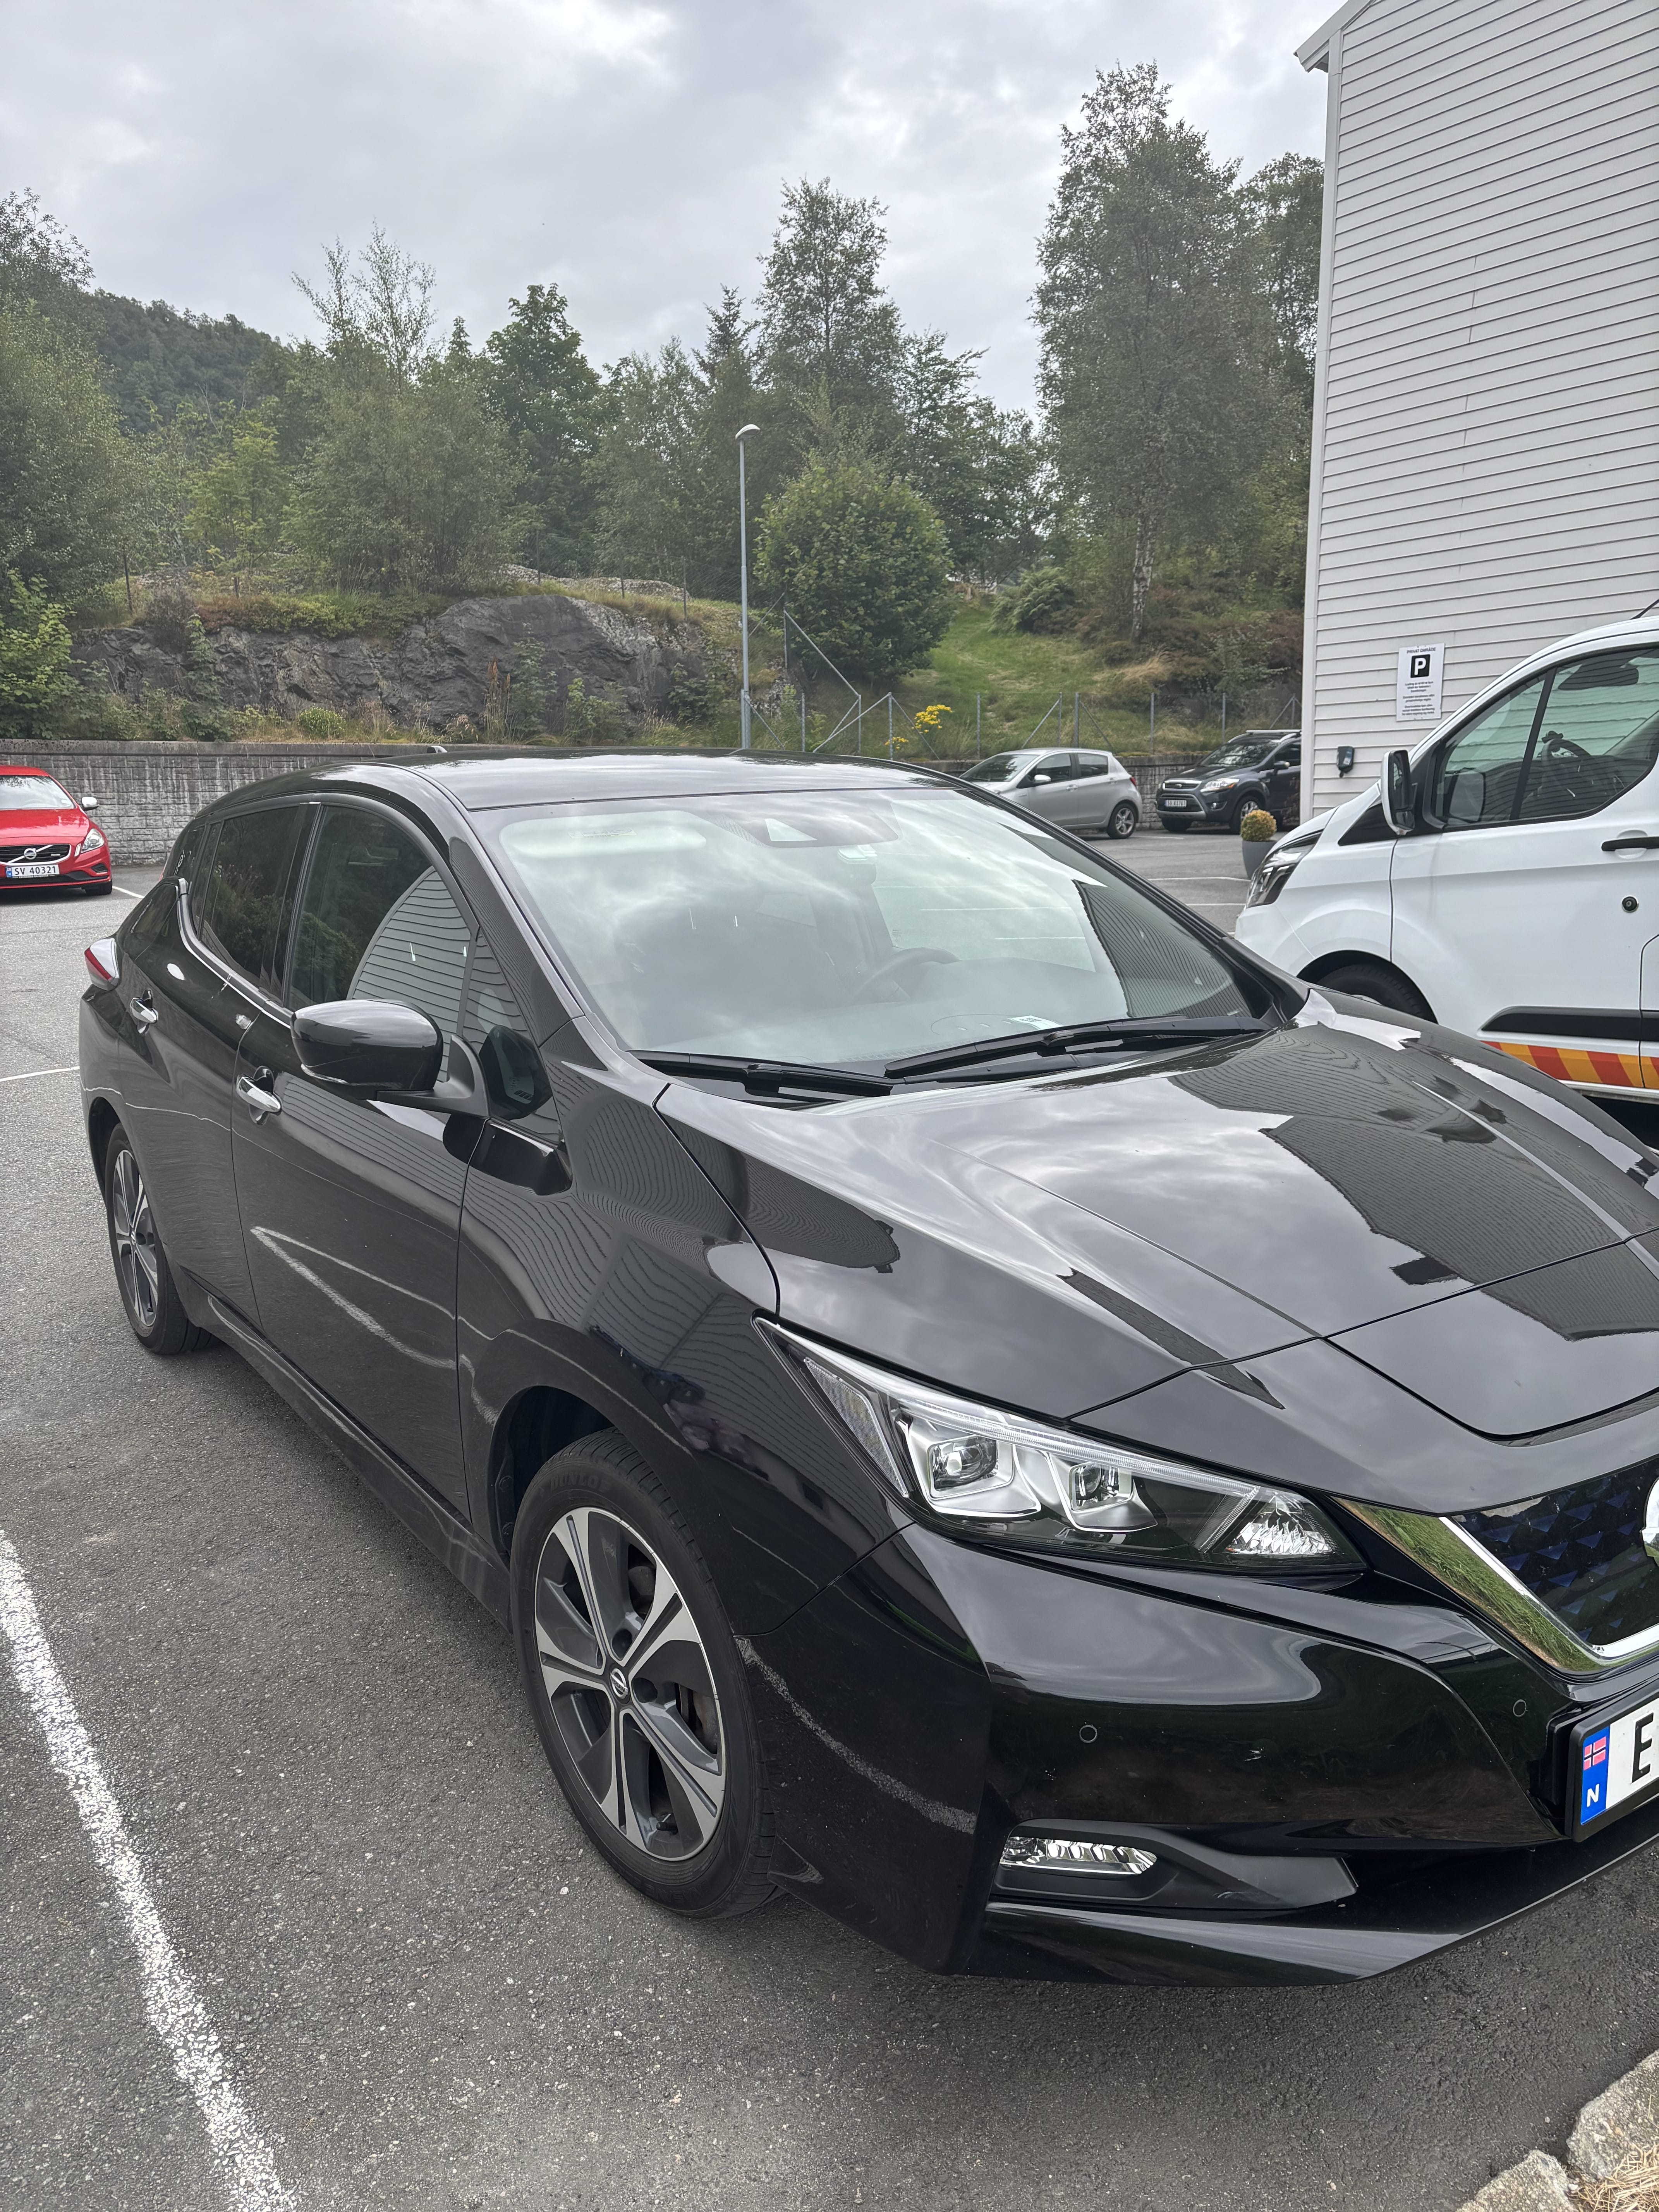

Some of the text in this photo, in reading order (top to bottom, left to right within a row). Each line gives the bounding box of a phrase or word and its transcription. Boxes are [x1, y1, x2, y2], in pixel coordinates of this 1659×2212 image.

[1414, 658, 1426, 675] P
[29, 866, 55, 874] 40321
[1587, 1783, 1599, 1807] N
